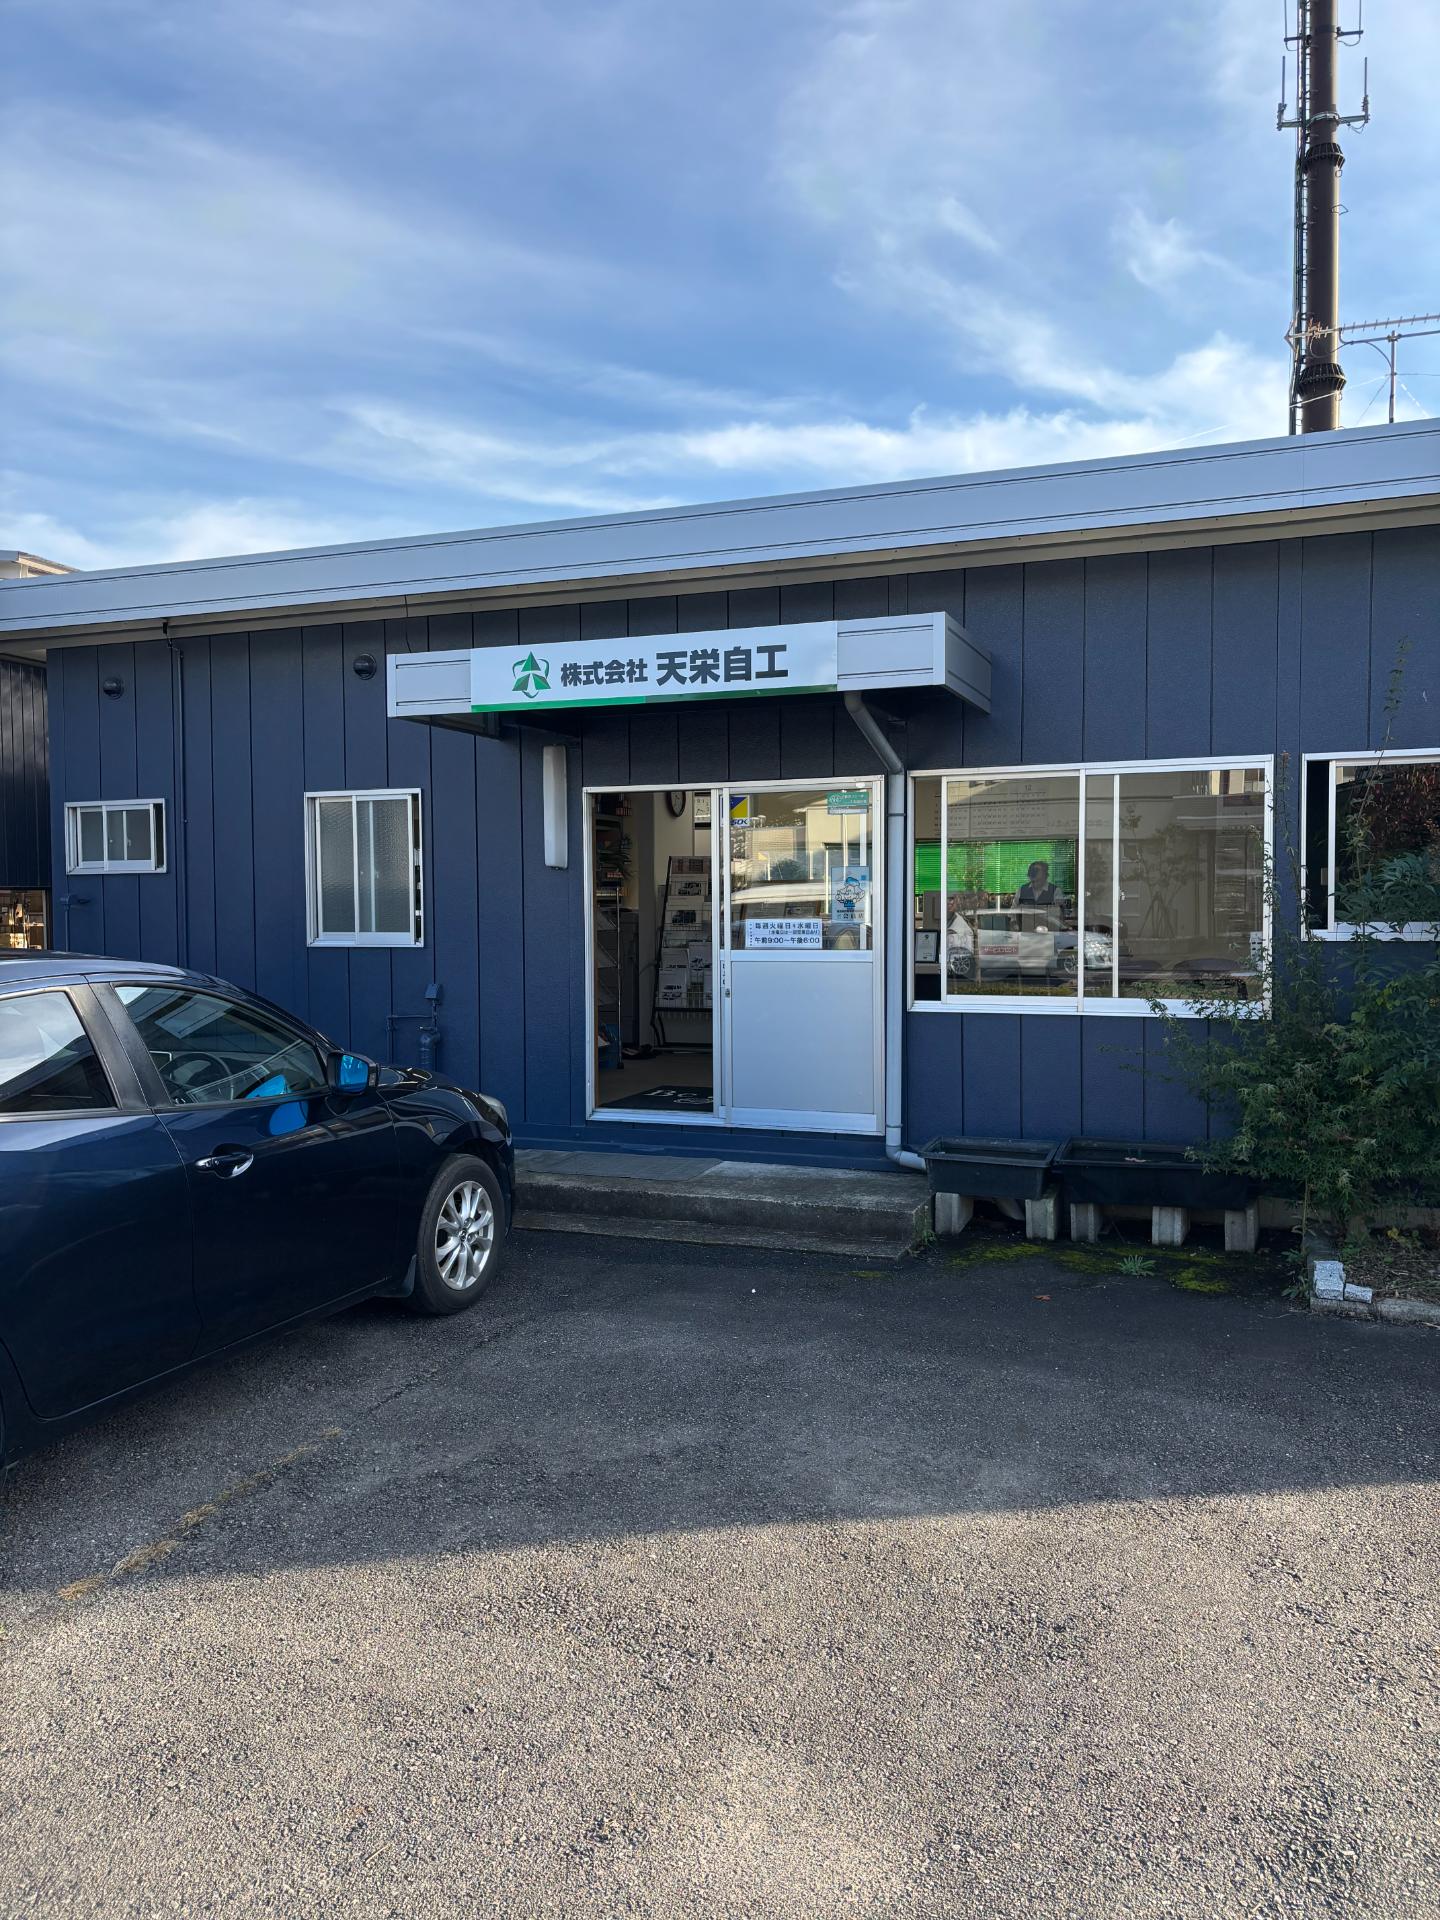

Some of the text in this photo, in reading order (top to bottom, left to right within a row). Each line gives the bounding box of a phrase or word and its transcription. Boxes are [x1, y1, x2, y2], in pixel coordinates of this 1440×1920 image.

[561, 645, 788, 686] 株式会社 天栄自工
